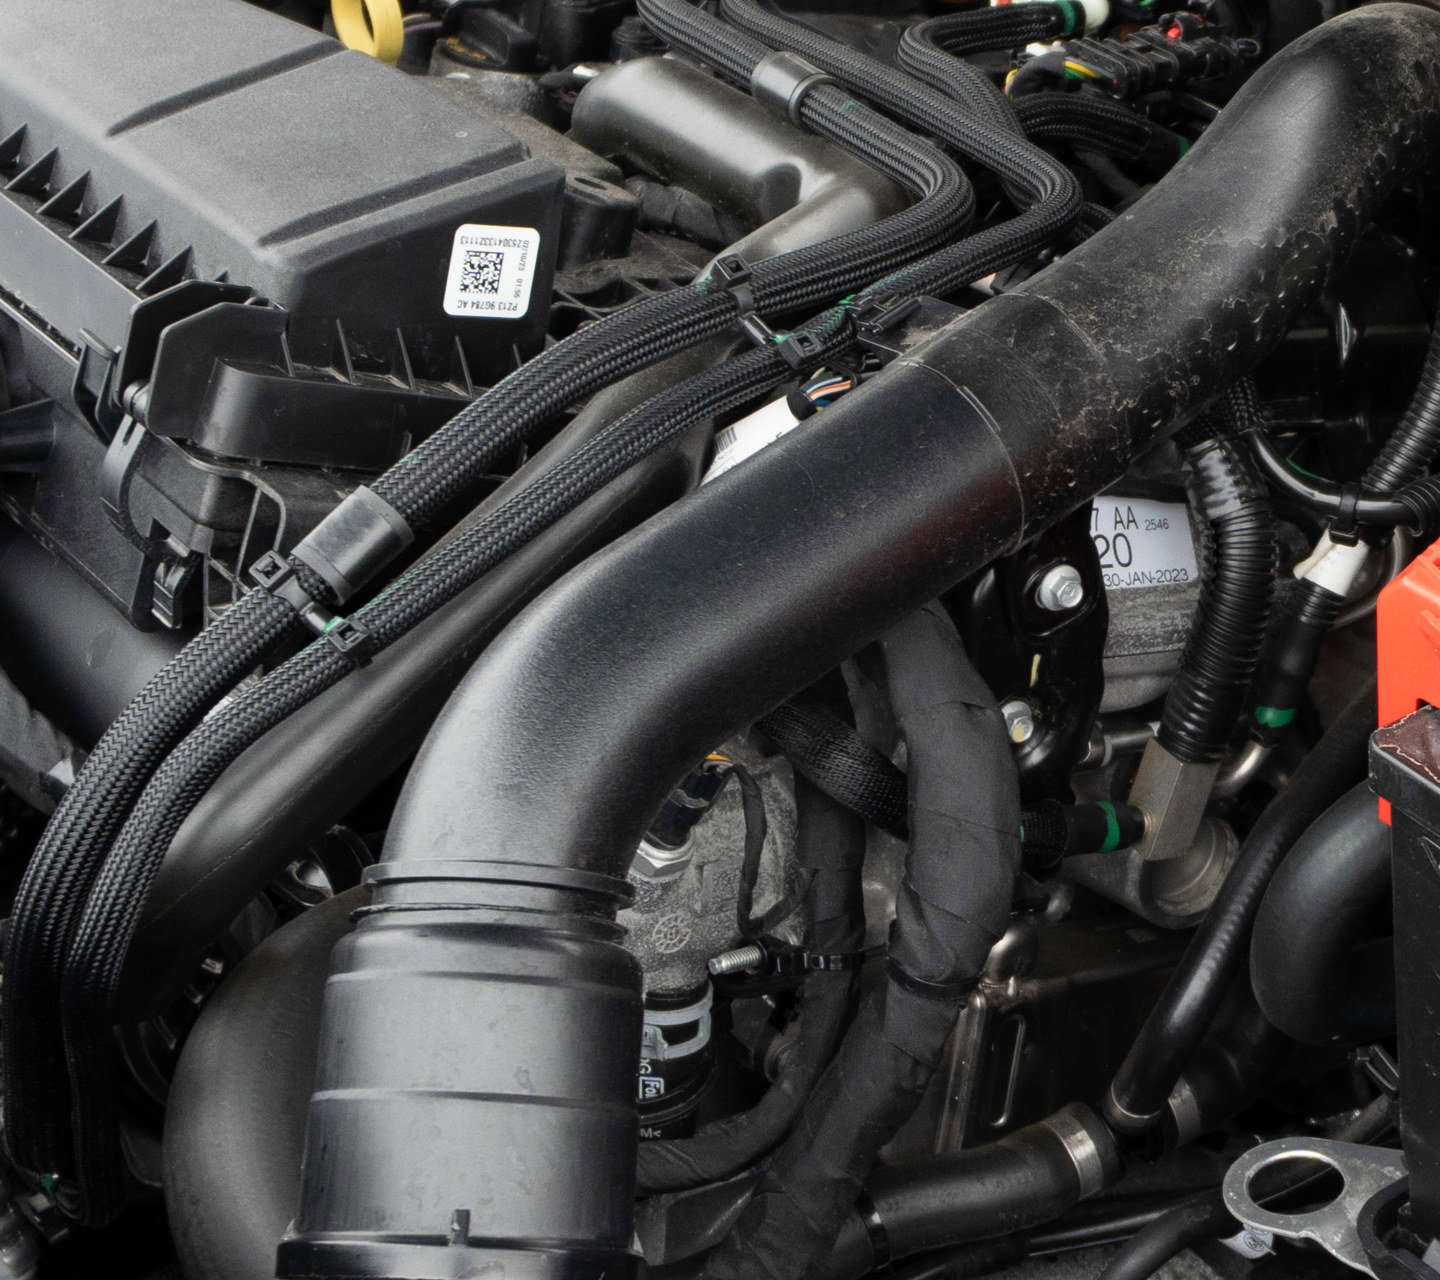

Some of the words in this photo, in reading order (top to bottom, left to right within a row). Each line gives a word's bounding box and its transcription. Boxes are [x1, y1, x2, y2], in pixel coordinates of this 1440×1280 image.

[456, 299, 468, 309] AC
[470, 299, 495, 311] 9G784
[497, 300, 518, 312] PZ13
[1114, 505, 1138, 531] AA
[1144, 518, 1169, 531] 2546
[1103, 567, 1189, 586] 30-JAN-2023
